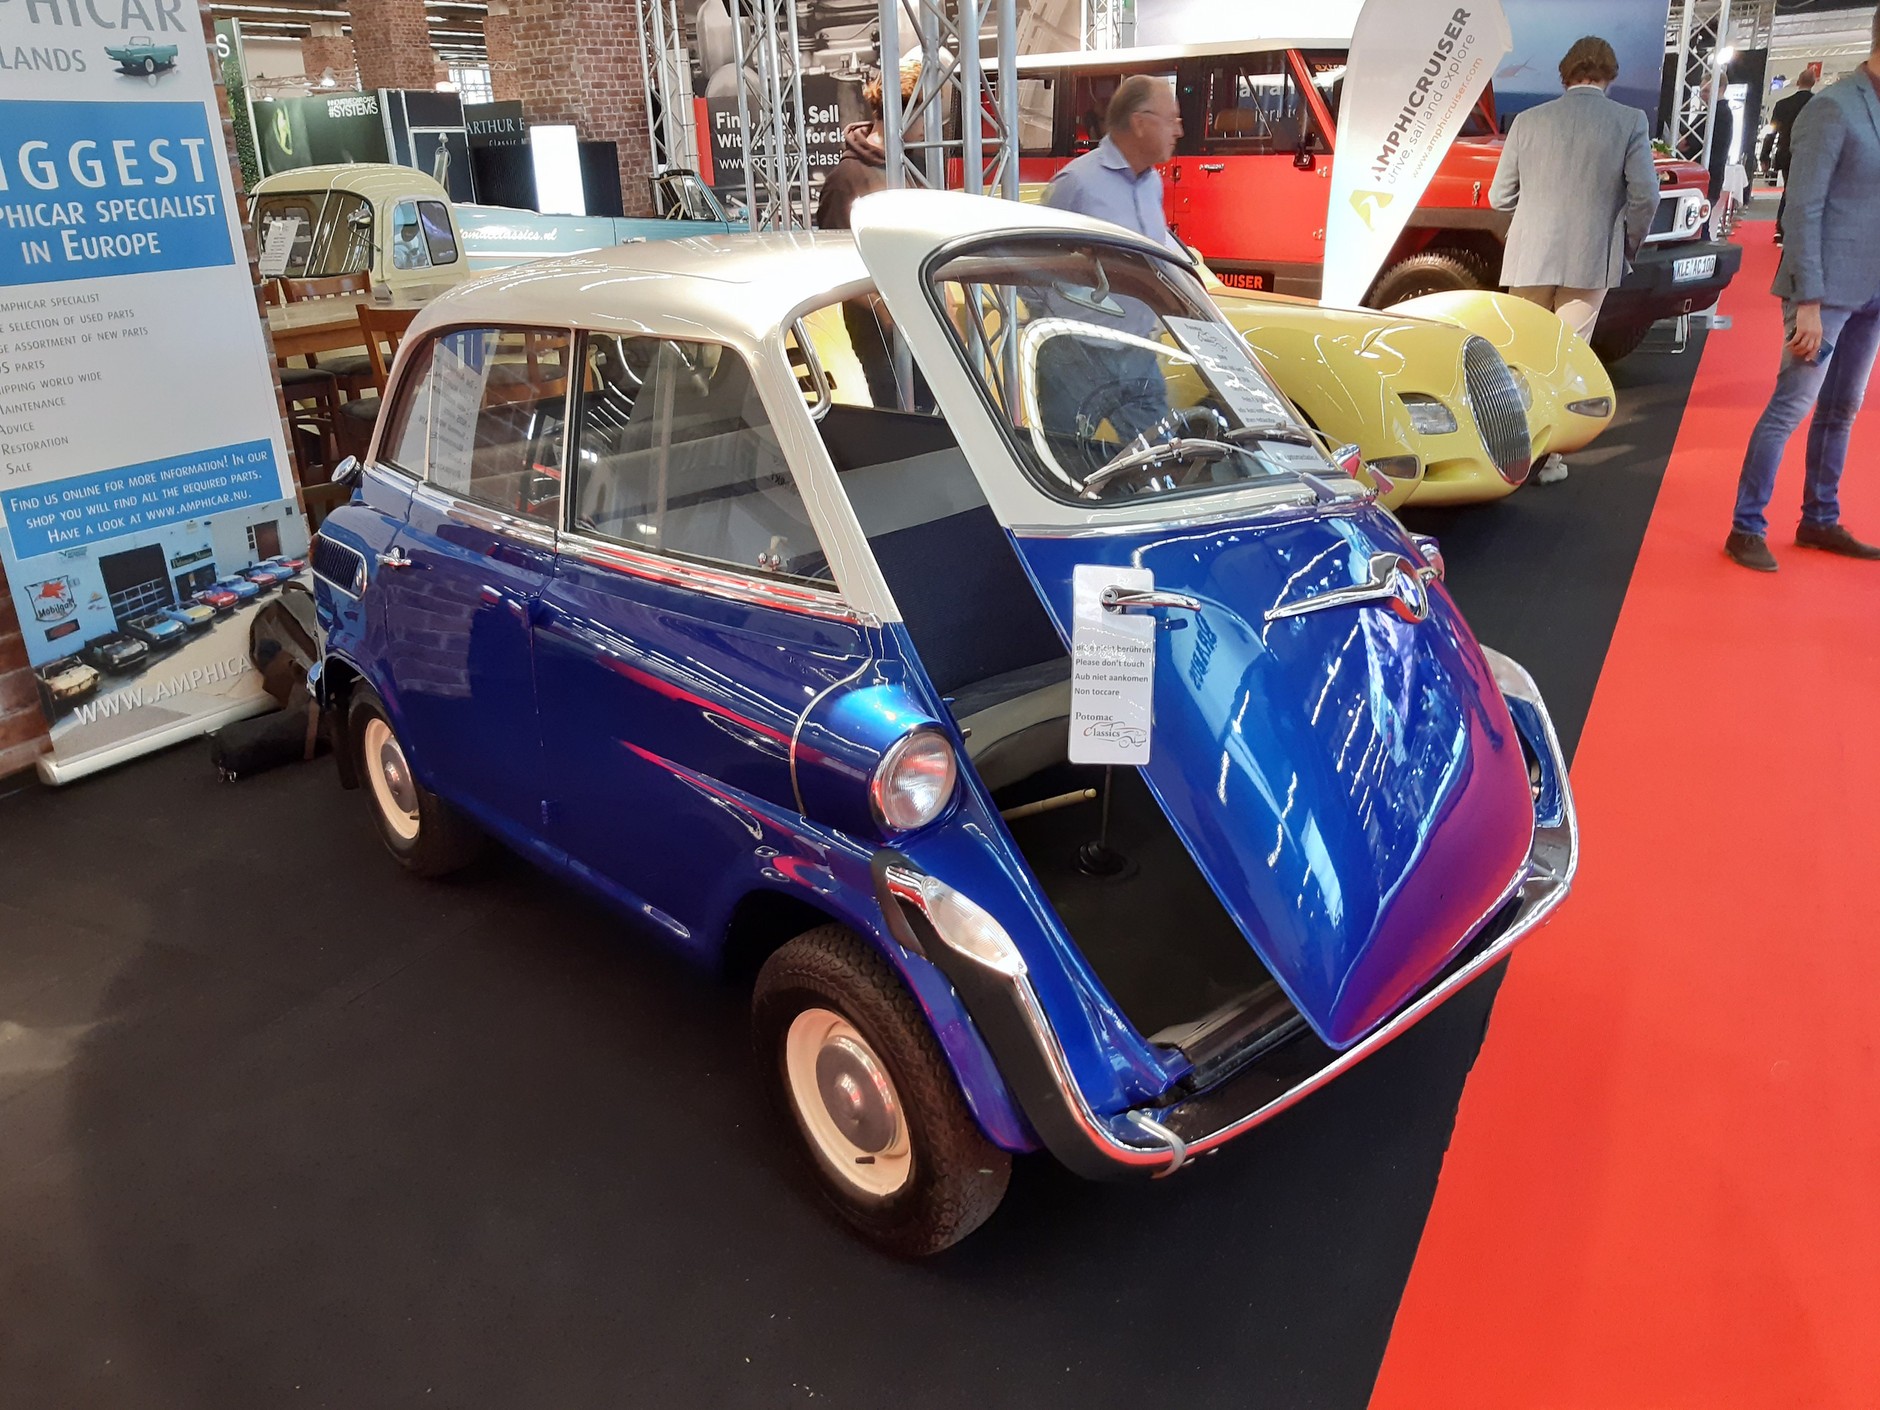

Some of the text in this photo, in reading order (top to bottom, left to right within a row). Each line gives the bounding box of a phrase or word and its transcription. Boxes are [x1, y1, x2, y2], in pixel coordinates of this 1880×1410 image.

[1371, 8, 1472, 182] AMPHICRUISER
[1409, 121, 1427, 145] sail
[1423, 89, 1443, 121] and
[1440, 34, 1476, 91] explore
[328, 102, 379, 119] #SYSTEMS
[808, 104, 840, 124] Sell
[1412, 57, 1484, 179] www.amphicruiser.com
[466, 118, 515, 135] ARTHUR
[717, 131, 744, 149] Wit
[805, 128, 827, 145] for
[96, 194, 216, 224] SPECIALIST
[21, 240, 52, 265] IN
[0, 292, 101, 313] MPHICAR SPECIALIST
[8, 317, 60, 333] SELECTION
[63, 315, 76, 326] OF
[79, 312, 104, 324] USED
[107, 308, 135, 321] PARTS
[14, 335, 77, 353] ASSORTMENT
[81, 333, 93, 344] OF
[97, 330, 119, 341] NEW
[122, 326, 149, 338] PARTS
[15, 359, 46, 373] PARTS
[0, 371, 103, 396] IPPING WORLD WIDE
[1, 435, 70, 456] RESTORATION
[10, 496, 40, 513] FIND
[43, 493, 59, 506] US
[62, 484, 102, 502] ONLINE
[104, 479, 125, 493] FOR
[128, 472, 158, 488] MORE
[160, 454, 229, 480] INFORMATION!
[247, 450, 268, 463] OUR
[26, 469, 263, 529] SHOP YOU WILL FIND ALL THE REQUIRED PARTS.
[47, 526, 81, 544] HAVE
[85, 524, 94, 536] A
[97, 517, 126, 533] LOOK
[130, 513, 142, 525] AT
[1116, 644, 1152, 654] berühren
[1075, 658, 1145, 669] Please don't touch
[1074, 672, 1149, 683] Aub niet aankomen
[1074, 687, 1120, 697] Non toccare
[1075, 711, 1114, 722] Potomac
[1083, 726, 1121, 738] Classics
